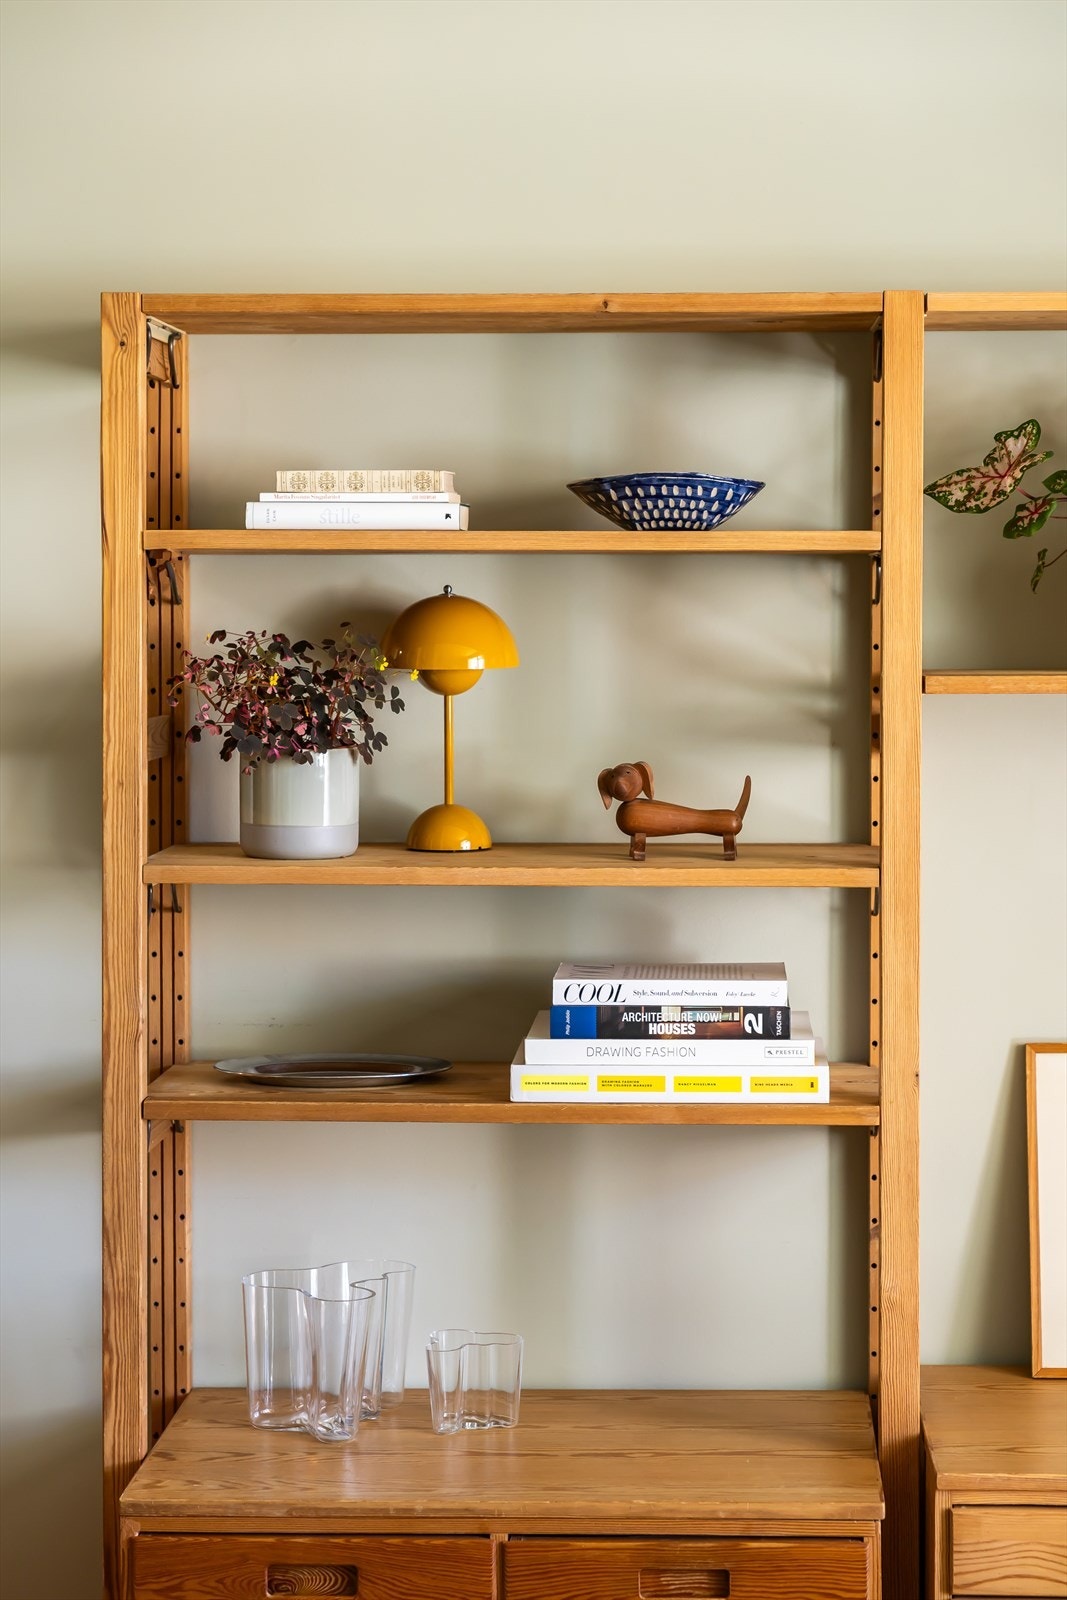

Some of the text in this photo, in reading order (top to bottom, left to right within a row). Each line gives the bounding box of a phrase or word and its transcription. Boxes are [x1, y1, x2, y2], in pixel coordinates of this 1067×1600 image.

[319, 507, 360, 524] stille
[563, 982, 627, 1003] COOL
[684, 989, 718, 997] Subversion
[622, 1012, 722, 1023] ARCHITECTURE NOW!
[648, 1023, 696, 1035] HOUSES
[743, 1013, 763, 1035] 2
[586, 1046, 696, 1058] DRAWING FASHION
